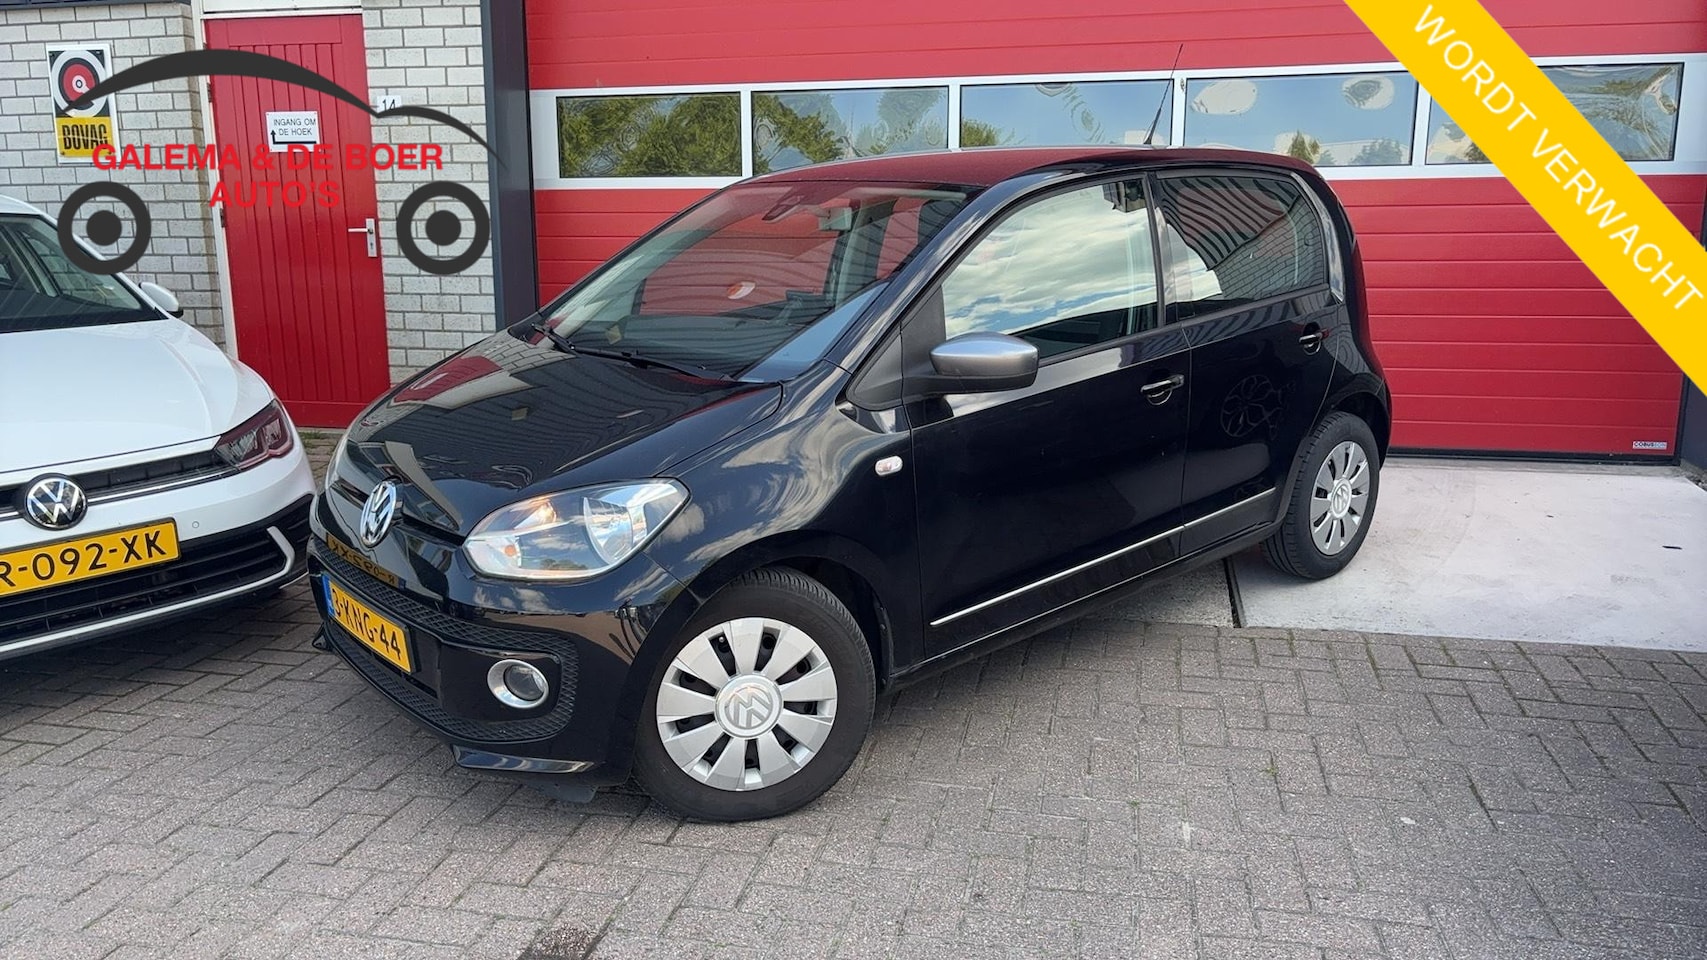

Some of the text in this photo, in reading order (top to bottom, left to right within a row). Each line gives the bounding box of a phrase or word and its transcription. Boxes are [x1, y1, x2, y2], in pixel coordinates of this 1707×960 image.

[273, 117, 316, 126] INGANG OM
[62, 123, 108, 150] BOVAG
[279, 127, 313, 137] DE HOEK
[331, 588, 402, 661] 3-KNG-44
